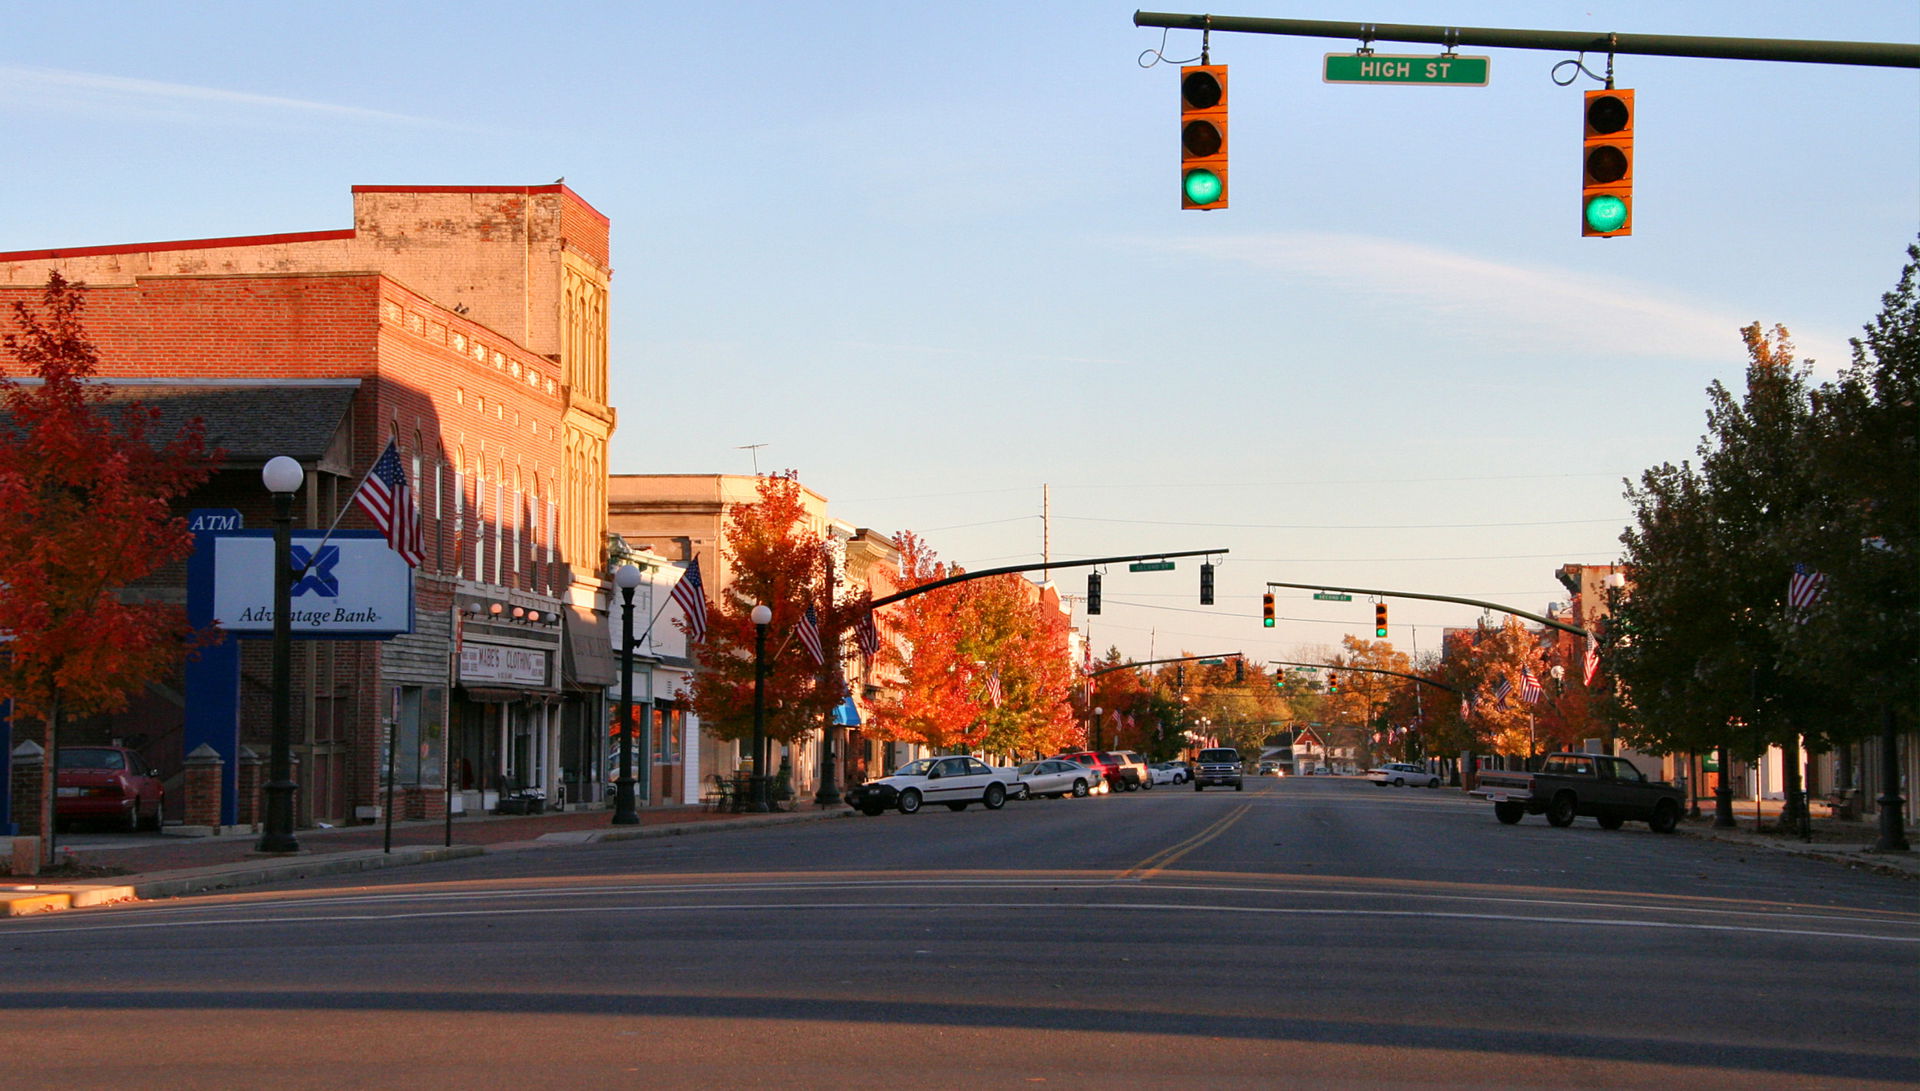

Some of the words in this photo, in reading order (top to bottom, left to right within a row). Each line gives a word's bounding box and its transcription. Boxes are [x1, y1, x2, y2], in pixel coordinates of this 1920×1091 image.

[1360, 61, 1410, 78] HIGH
[1425, 63, 1451, 79] ST
[190, 515, 236, 531] ATM
[239, 606, 331, 626] Advntage
[333, 607, 377, 623] Bank
[506, 649, 532, 671] CLOTHING
